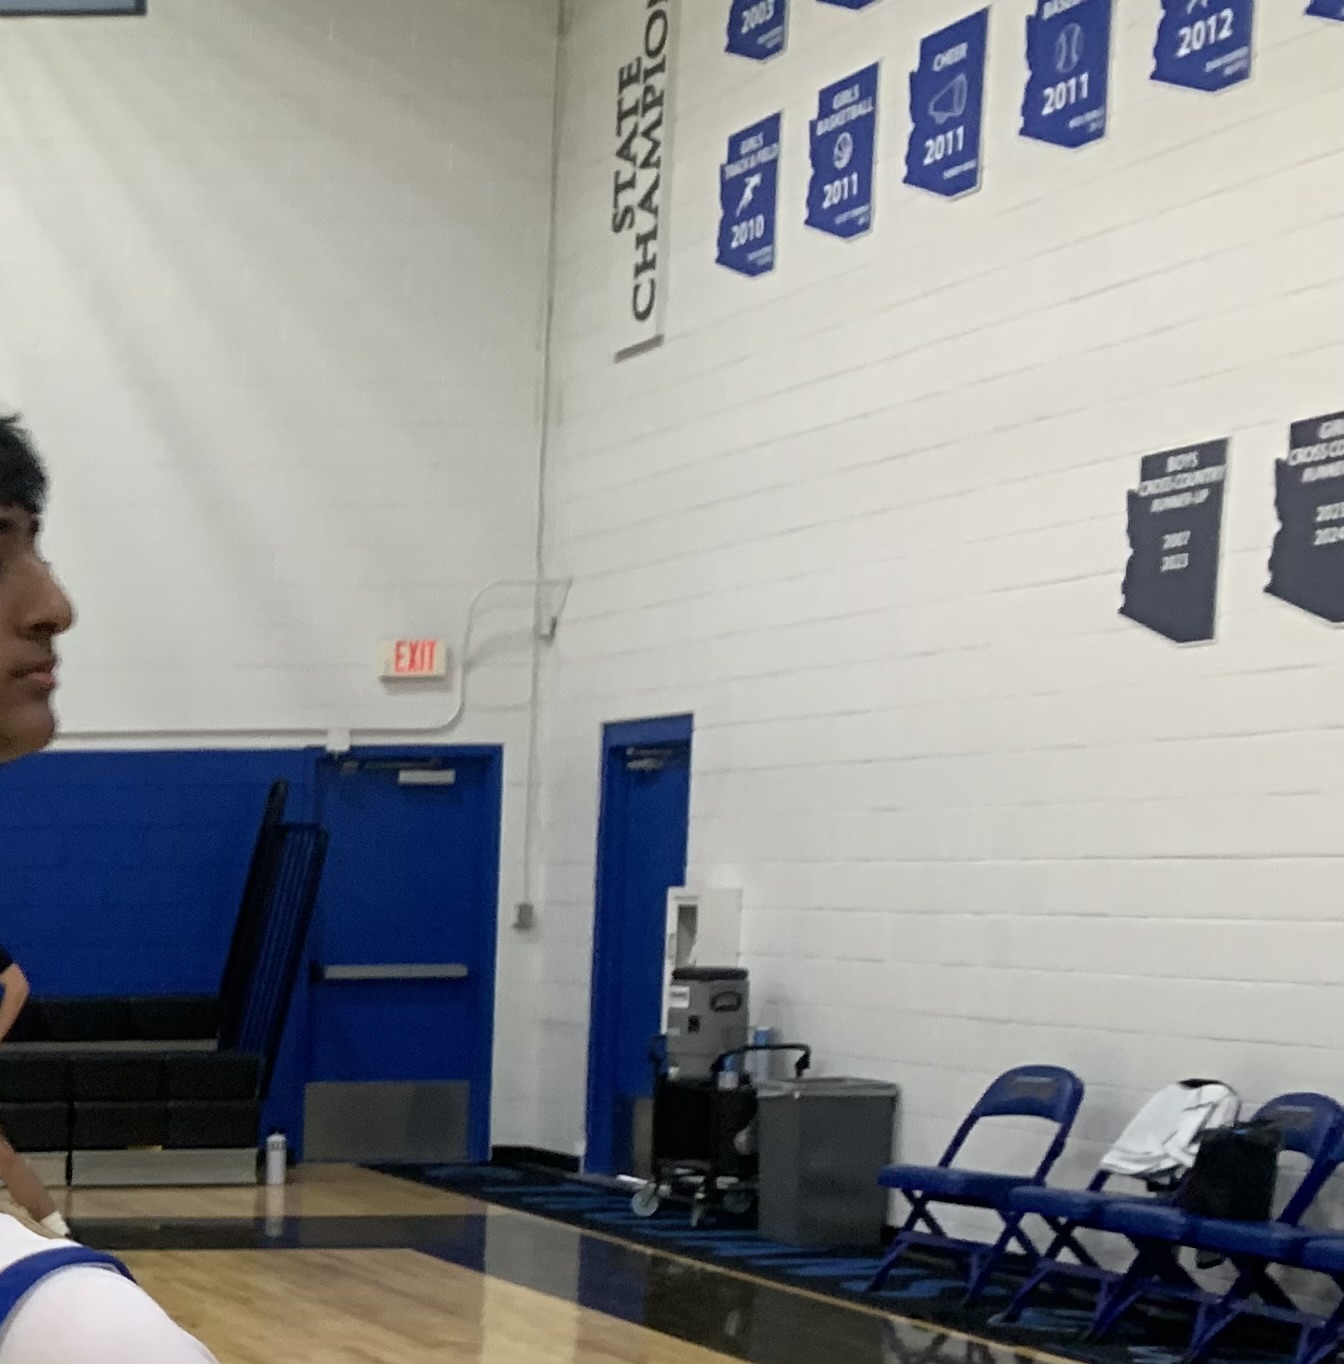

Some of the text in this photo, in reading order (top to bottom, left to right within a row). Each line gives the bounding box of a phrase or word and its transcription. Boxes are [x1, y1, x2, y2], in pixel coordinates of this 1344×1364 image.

[1175, 8, 1234, 58] 2012
[1041, 72, 1089, 116] 2011
[612, 56, 642, 234] STATE
[632, 0, 669, 322] CHAMPIO
[923, 125, 964, 166] 2011
[822, 171, 859, 209] 2011
[731, 214, 764, 249] 2010
[395, 640, 436, 673] EXIT
